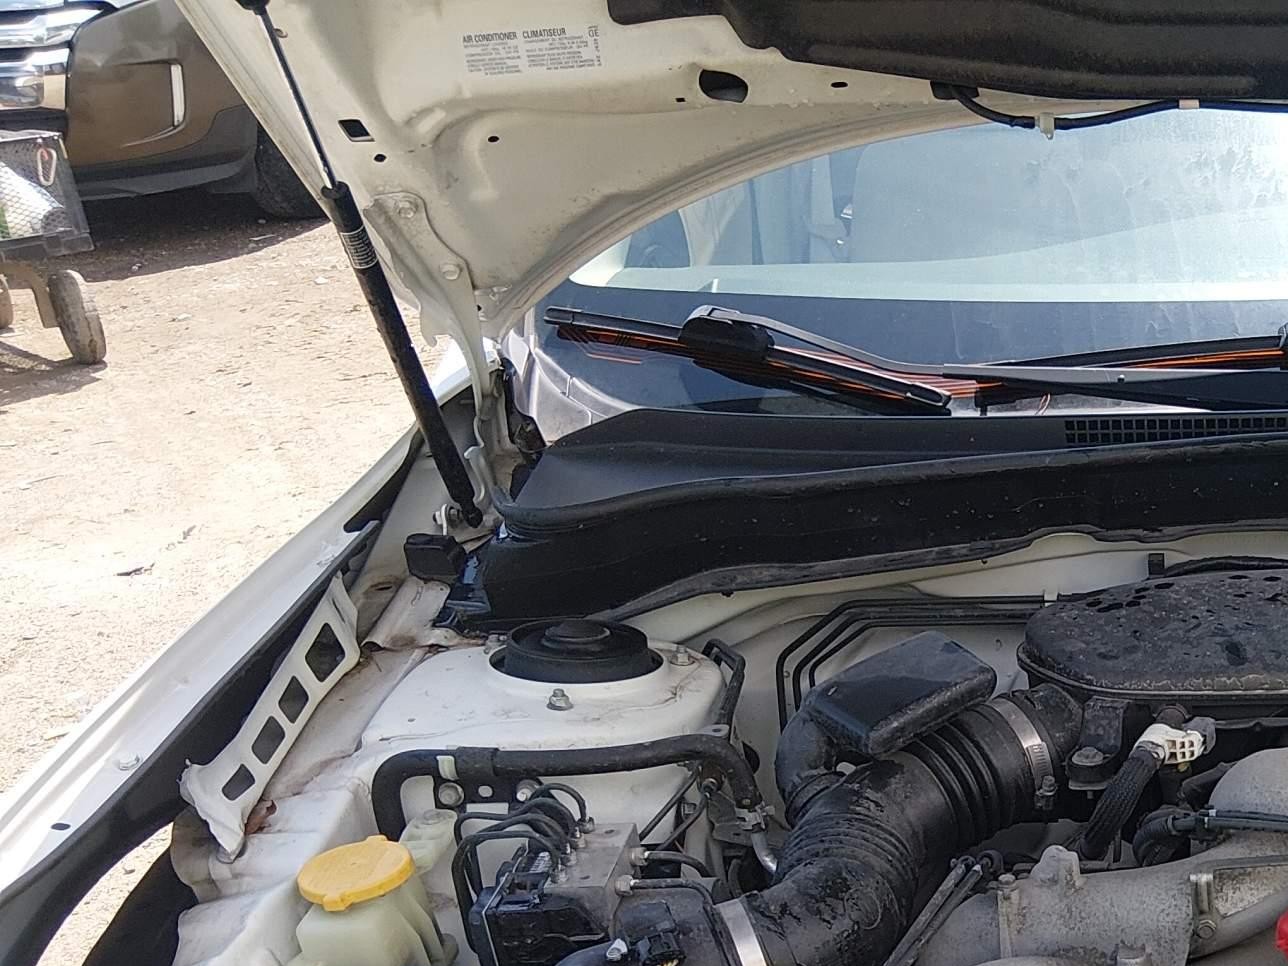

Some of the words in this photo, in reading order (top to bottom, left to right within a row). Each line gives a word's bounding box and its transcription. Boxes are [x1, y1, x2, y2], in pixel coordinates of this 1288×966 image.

[463, 34, 473, 43] AIR
[474, 31, 518, 43] CONDITIONER
[522, 27, 567, 39] CLIMATISEUR
